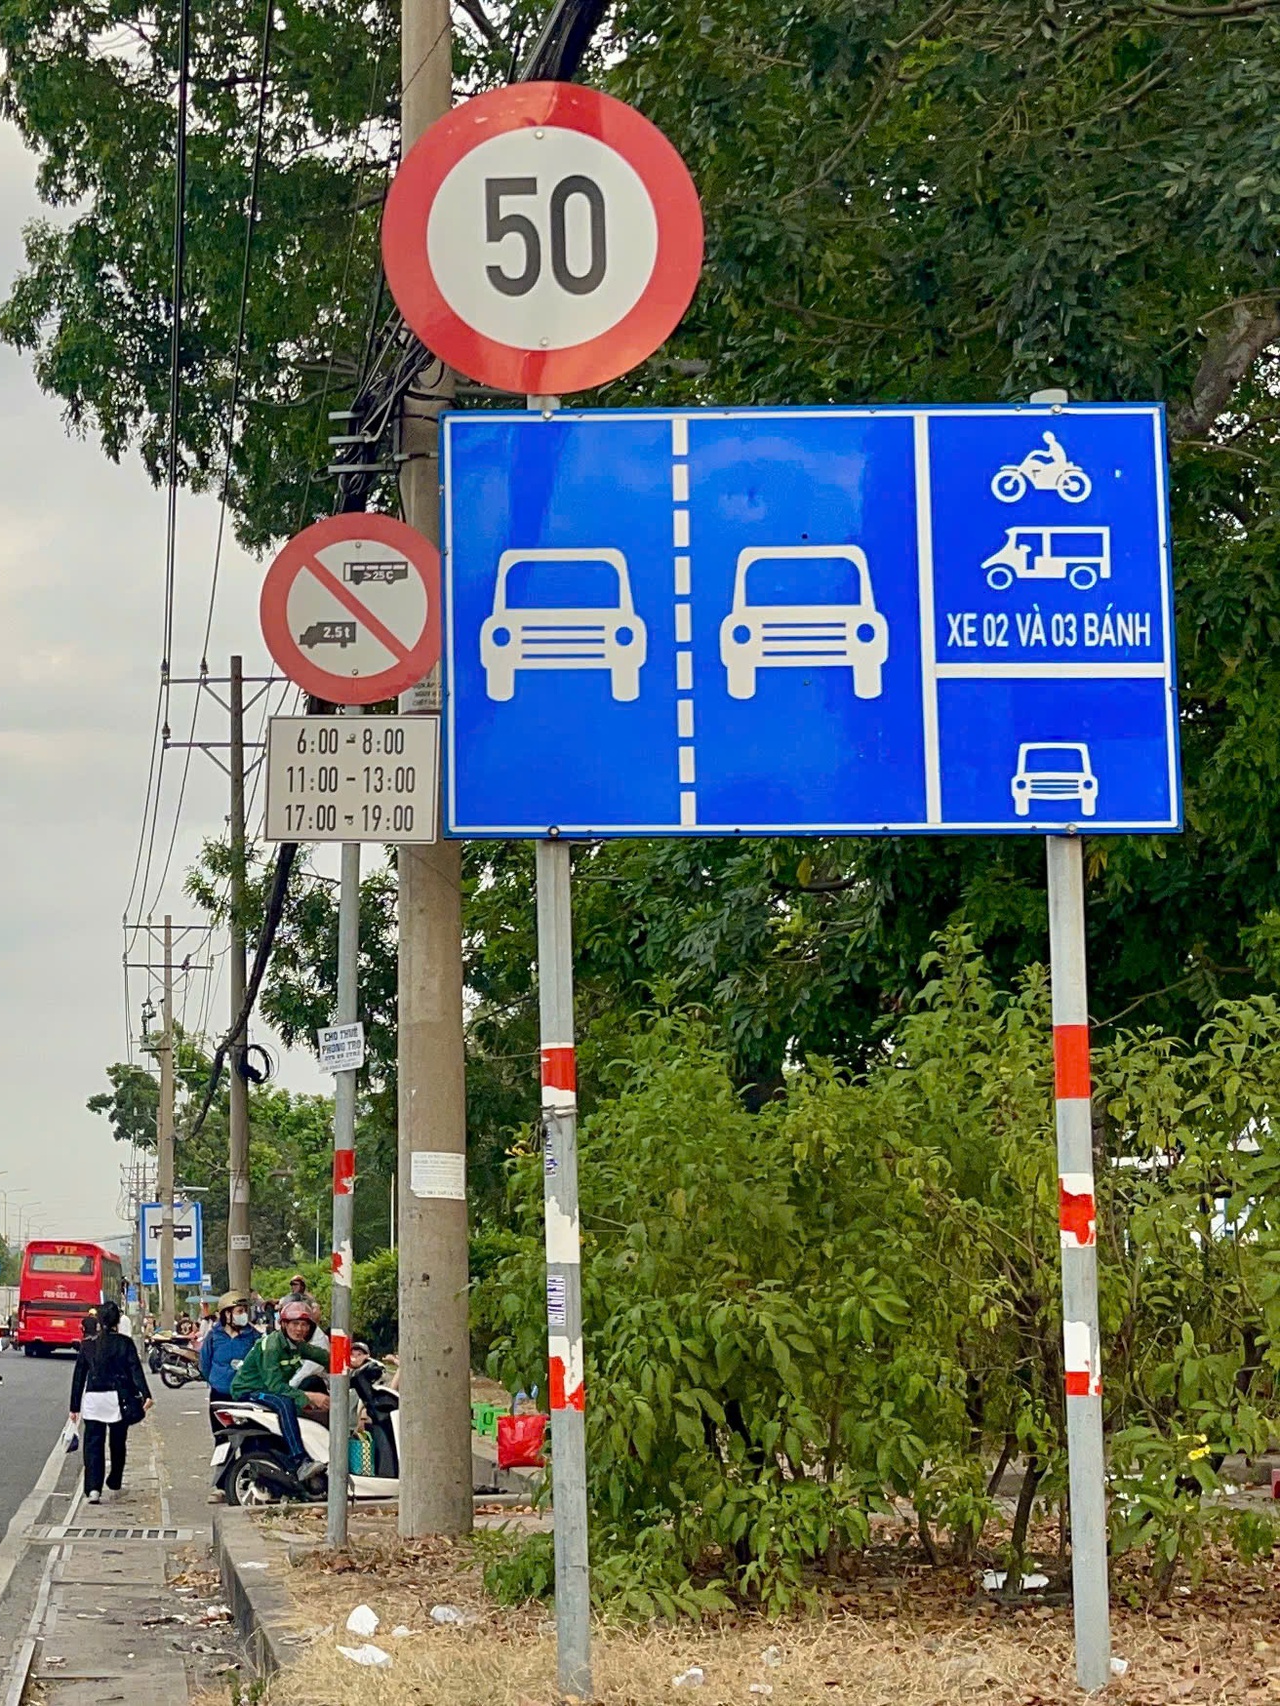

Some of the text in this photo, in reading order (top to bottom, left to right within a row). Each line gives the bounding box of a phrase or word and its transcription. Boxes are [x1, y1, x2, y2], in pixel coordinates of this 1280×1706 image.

[485, 174, 607, 298] 50
[946, 602, 1151, 647] XE 02 VÀ 03 BÁNH
[296, 727, 339, 755] 6:00
[362, 727, 405, 755] 8:00
[286, 766, 339, 793] 11:00
[363, 766, 415, 793] 13:00
[284, 804, 337, 832] 17:00
[361, 804, 414, 832] 19:00
[55, 1245, 78, 1255] VIP
